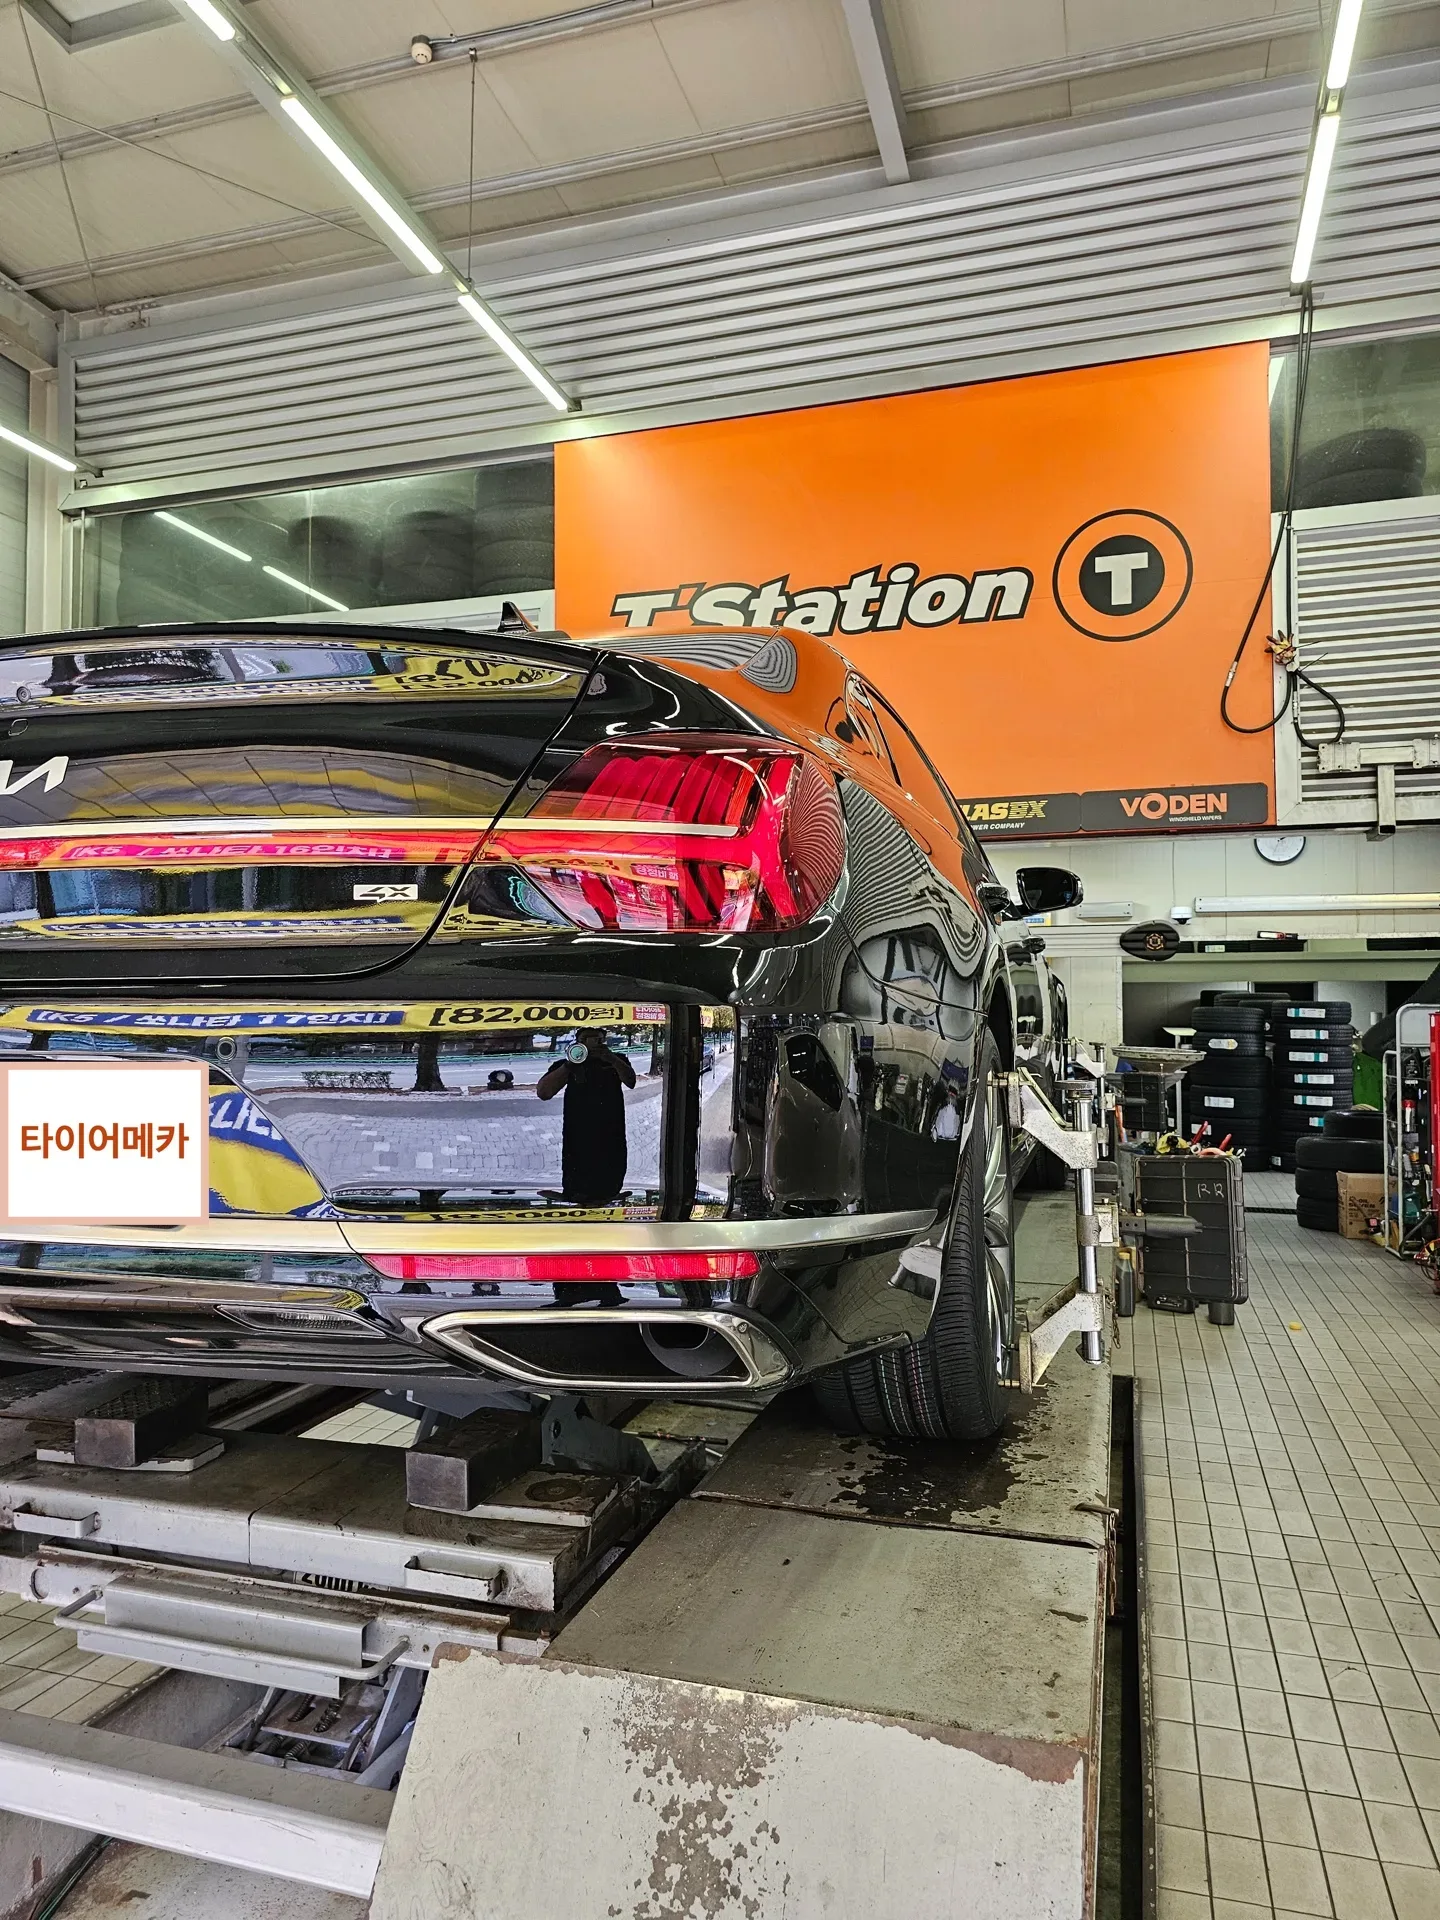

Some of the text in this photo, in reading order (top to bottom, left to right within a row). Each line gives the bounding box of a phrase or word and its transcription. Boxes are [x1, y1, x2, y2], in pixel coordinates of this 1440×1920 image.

[610, 562, 1034, 637] T'Station
[958, 799, 1049, 821] LASBX
[1119, 792, 1228, 820] VODEN
[989, 821, 1026, 830] COMPANY
[1169, 815, 1201, 823] WINDSHIELD
[36, 1010, 99, 1022] [K5
[134, 1014, 243, 1028] 쏘나타
[258, 1013, 391, 1026] 17인치]
[428, 1005, 625, 1028] [82,000원]
